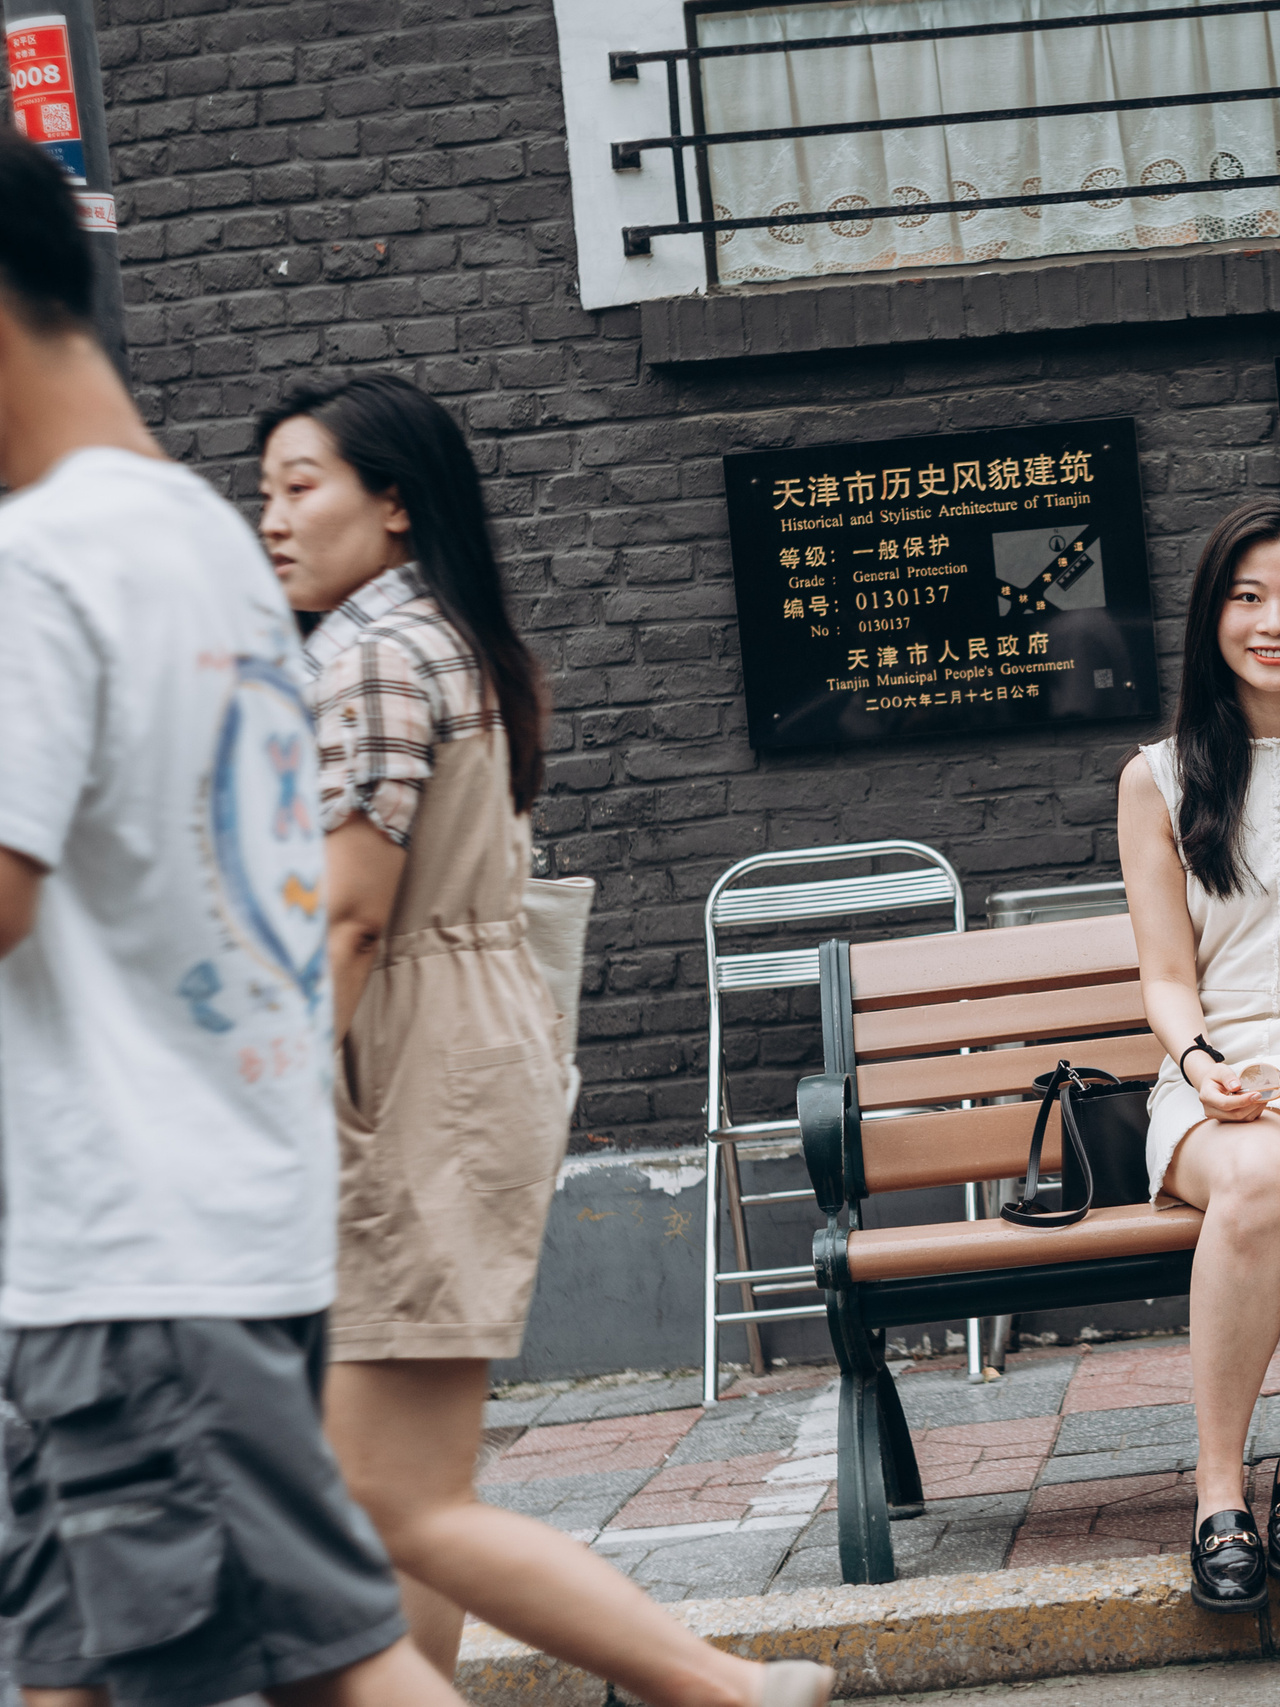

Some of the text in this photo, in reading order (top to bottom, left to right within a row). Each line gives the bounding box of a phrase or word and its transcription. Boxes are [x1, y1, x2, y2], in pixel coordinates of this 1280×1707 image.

[772, 449, 1094, 510] 天津市历史风貌建筑
[780, 491, 1091, 532] Historical and Stylistic Architecture of Tianjin
[852, 533, 950, 560] 一般保护
[788, 574, 825, 589] Grade
[852, 567, 900, 583] General
[906, 562, 968, 578] Protection
[855, 584, 949, 610] 0130137
[810, 624, 829, 637] No
[858, 616, 910, 633] 0130137
[847, 631, 1049, 671] 天津市人民政府
[825, 658, 1075, 692] Tianjin Municipal People's Government
